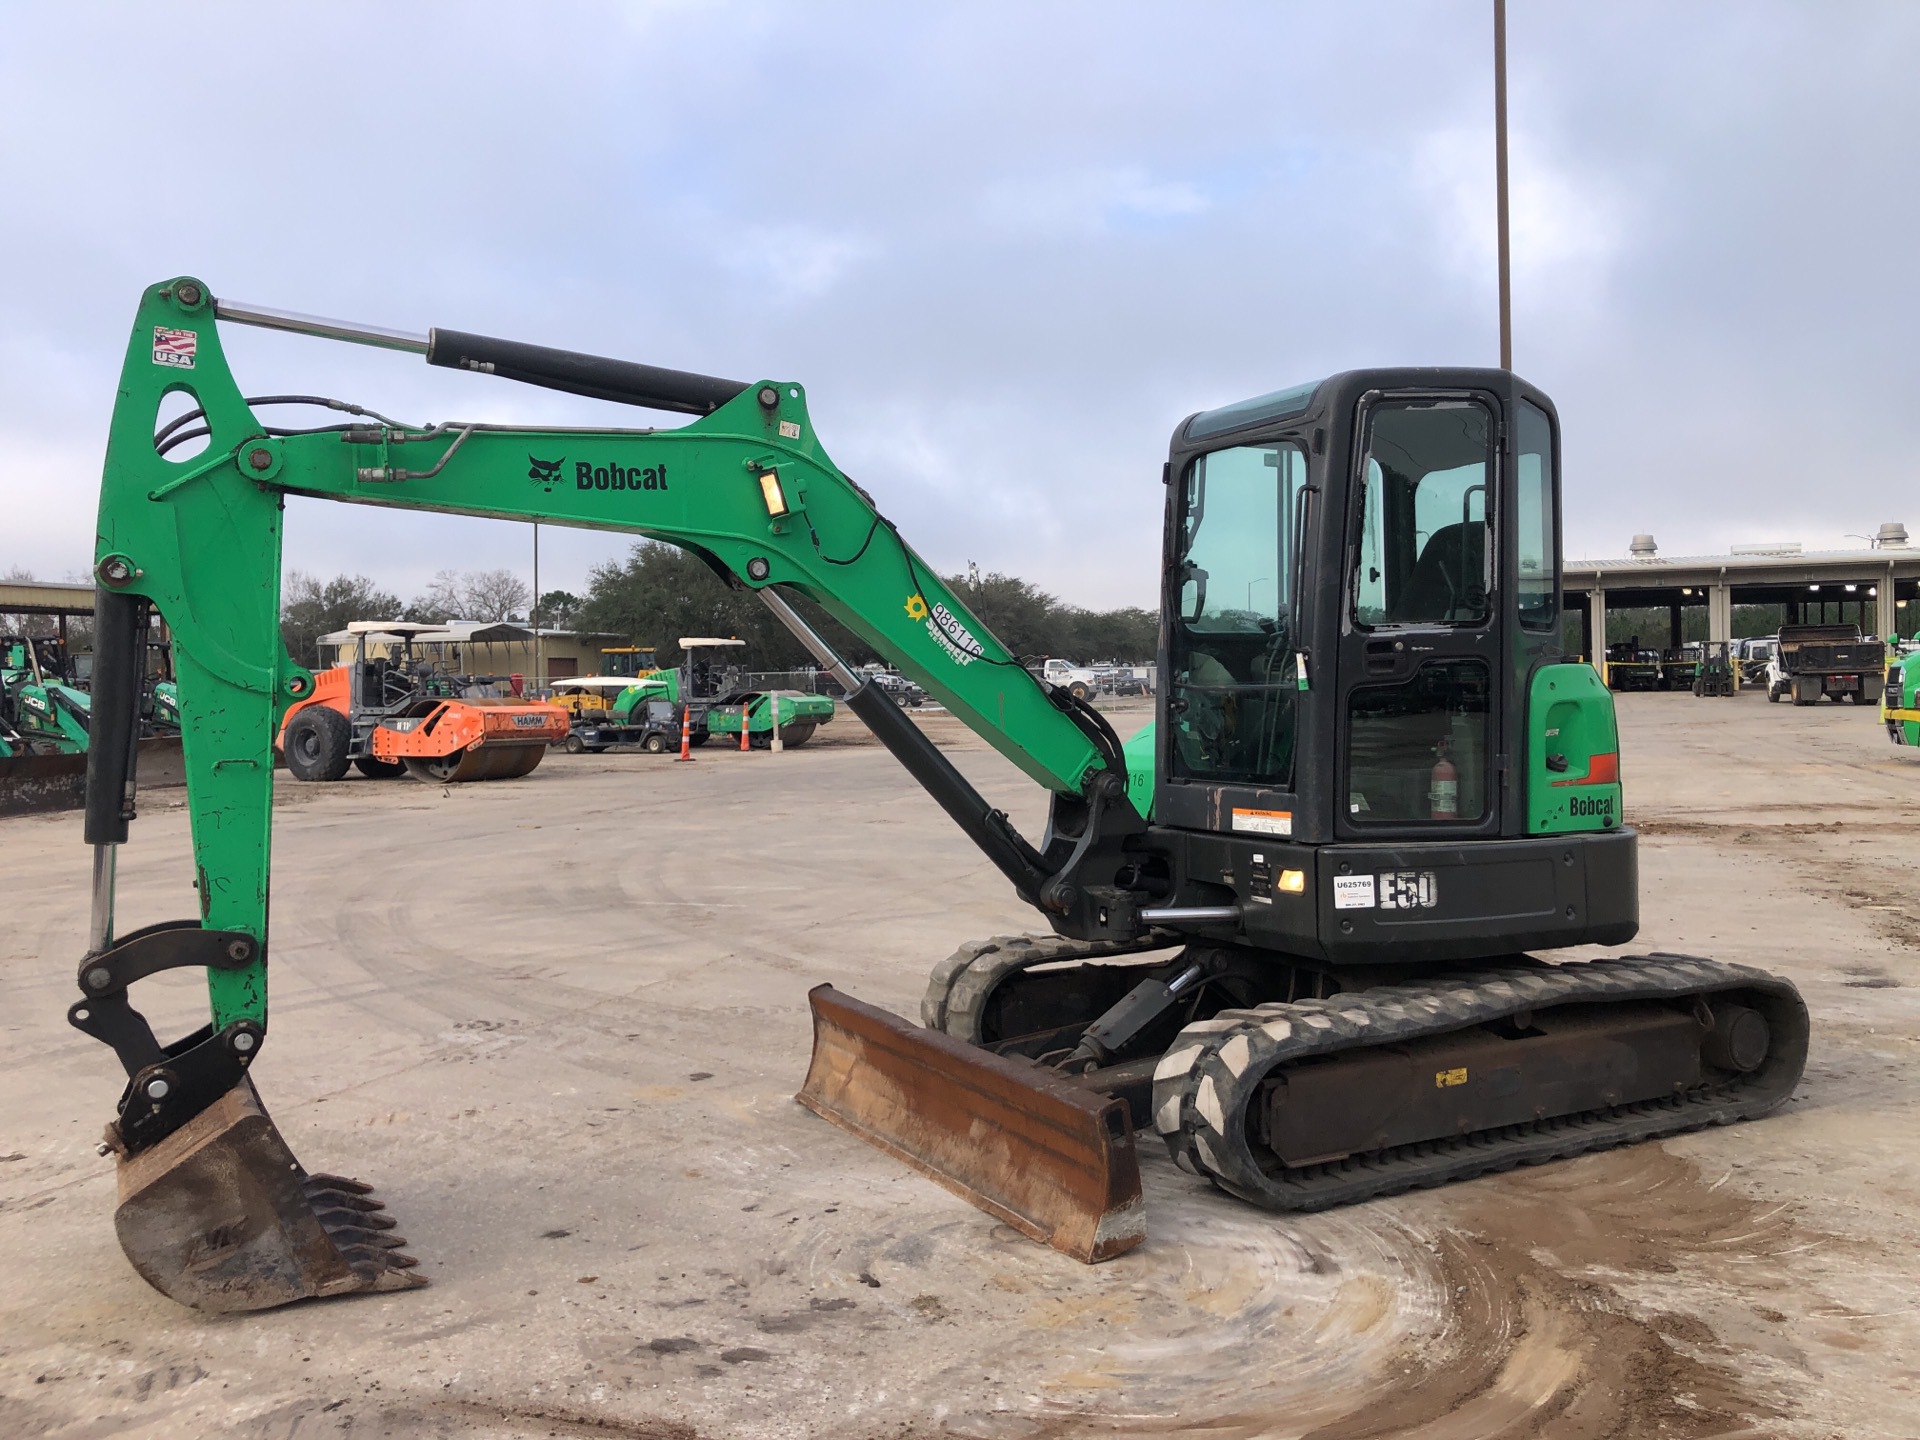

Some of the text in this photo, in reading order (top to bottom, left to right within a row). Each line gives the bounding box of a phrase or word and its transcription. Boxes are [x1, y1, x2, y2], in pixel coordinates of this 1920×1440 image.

[155, 351, 191, 365] USA
[576, 462, 668, 490] Bobcat
[935, 604, 983, 656] 986116
[24, 694, 46, 710] JCB
[159, 691, 176, 706] JCB
[516, 715, 543, 726] HAMM
[1570, 795, 1614, 816] Bobcat
[1337, 881, 1372, 889] U625769
[1380, 872, 1438, 909] E50
